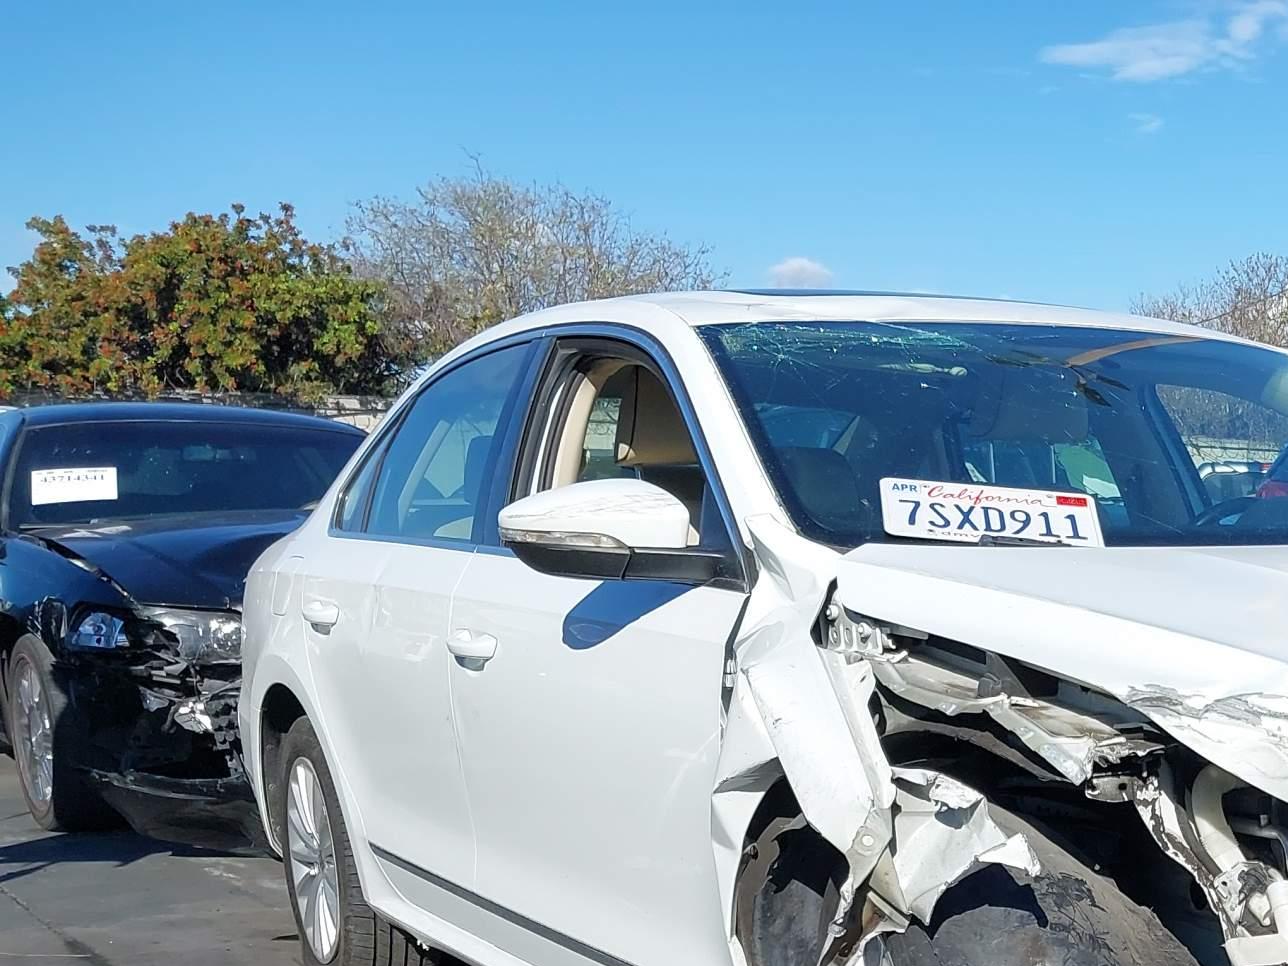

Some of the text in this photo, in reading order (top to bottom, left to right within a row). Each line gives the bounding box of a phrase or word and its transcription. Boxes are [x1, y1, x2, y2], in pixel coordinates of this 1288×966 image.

[891, 482, 918, 493] APR
[927, 485, 1054, 507] California
[898, 499, 1089, 540] 7SXD911
